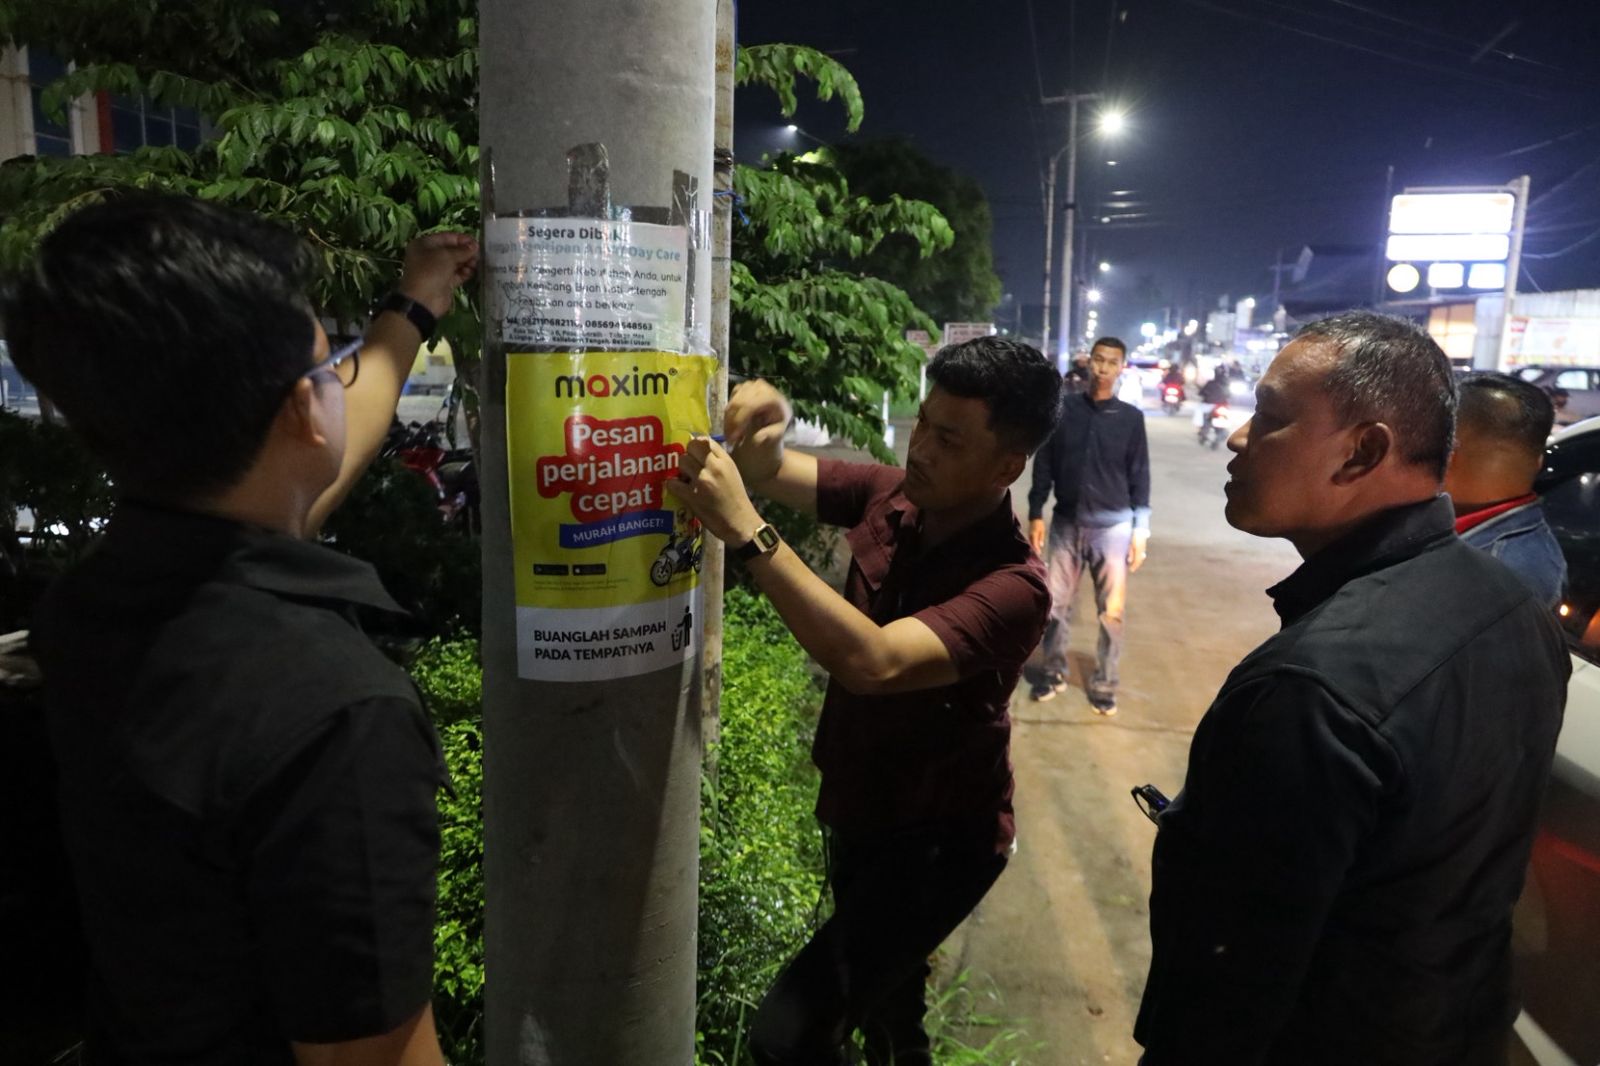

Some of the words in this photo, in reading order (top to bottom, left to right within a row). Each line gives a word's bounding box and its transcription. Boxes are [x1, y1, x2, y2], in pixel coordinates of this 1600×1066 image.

[528, 226, 575, 240] Segera
[629, 246, 653, 260] Day
[656, 248, 681, 261] Care
[661, 273, 682, 282] untuk
[554, 366, 669, 398] maxim
[573, 423, 654, 449] Pesan
[543, 449, 679, 487] perjalanan
[578, 483, 653, 515] cepat
[573, 525, 617, 543] MURAH
[618, 518, 665, 535] BANGET!
[534, 628, 610, 644] BUANGLAH
[613, 621, 667, 640] SAMPAH
[535, 647, 572, 661] PADA
[574, 642, 655, 661] TEMPATNYA
